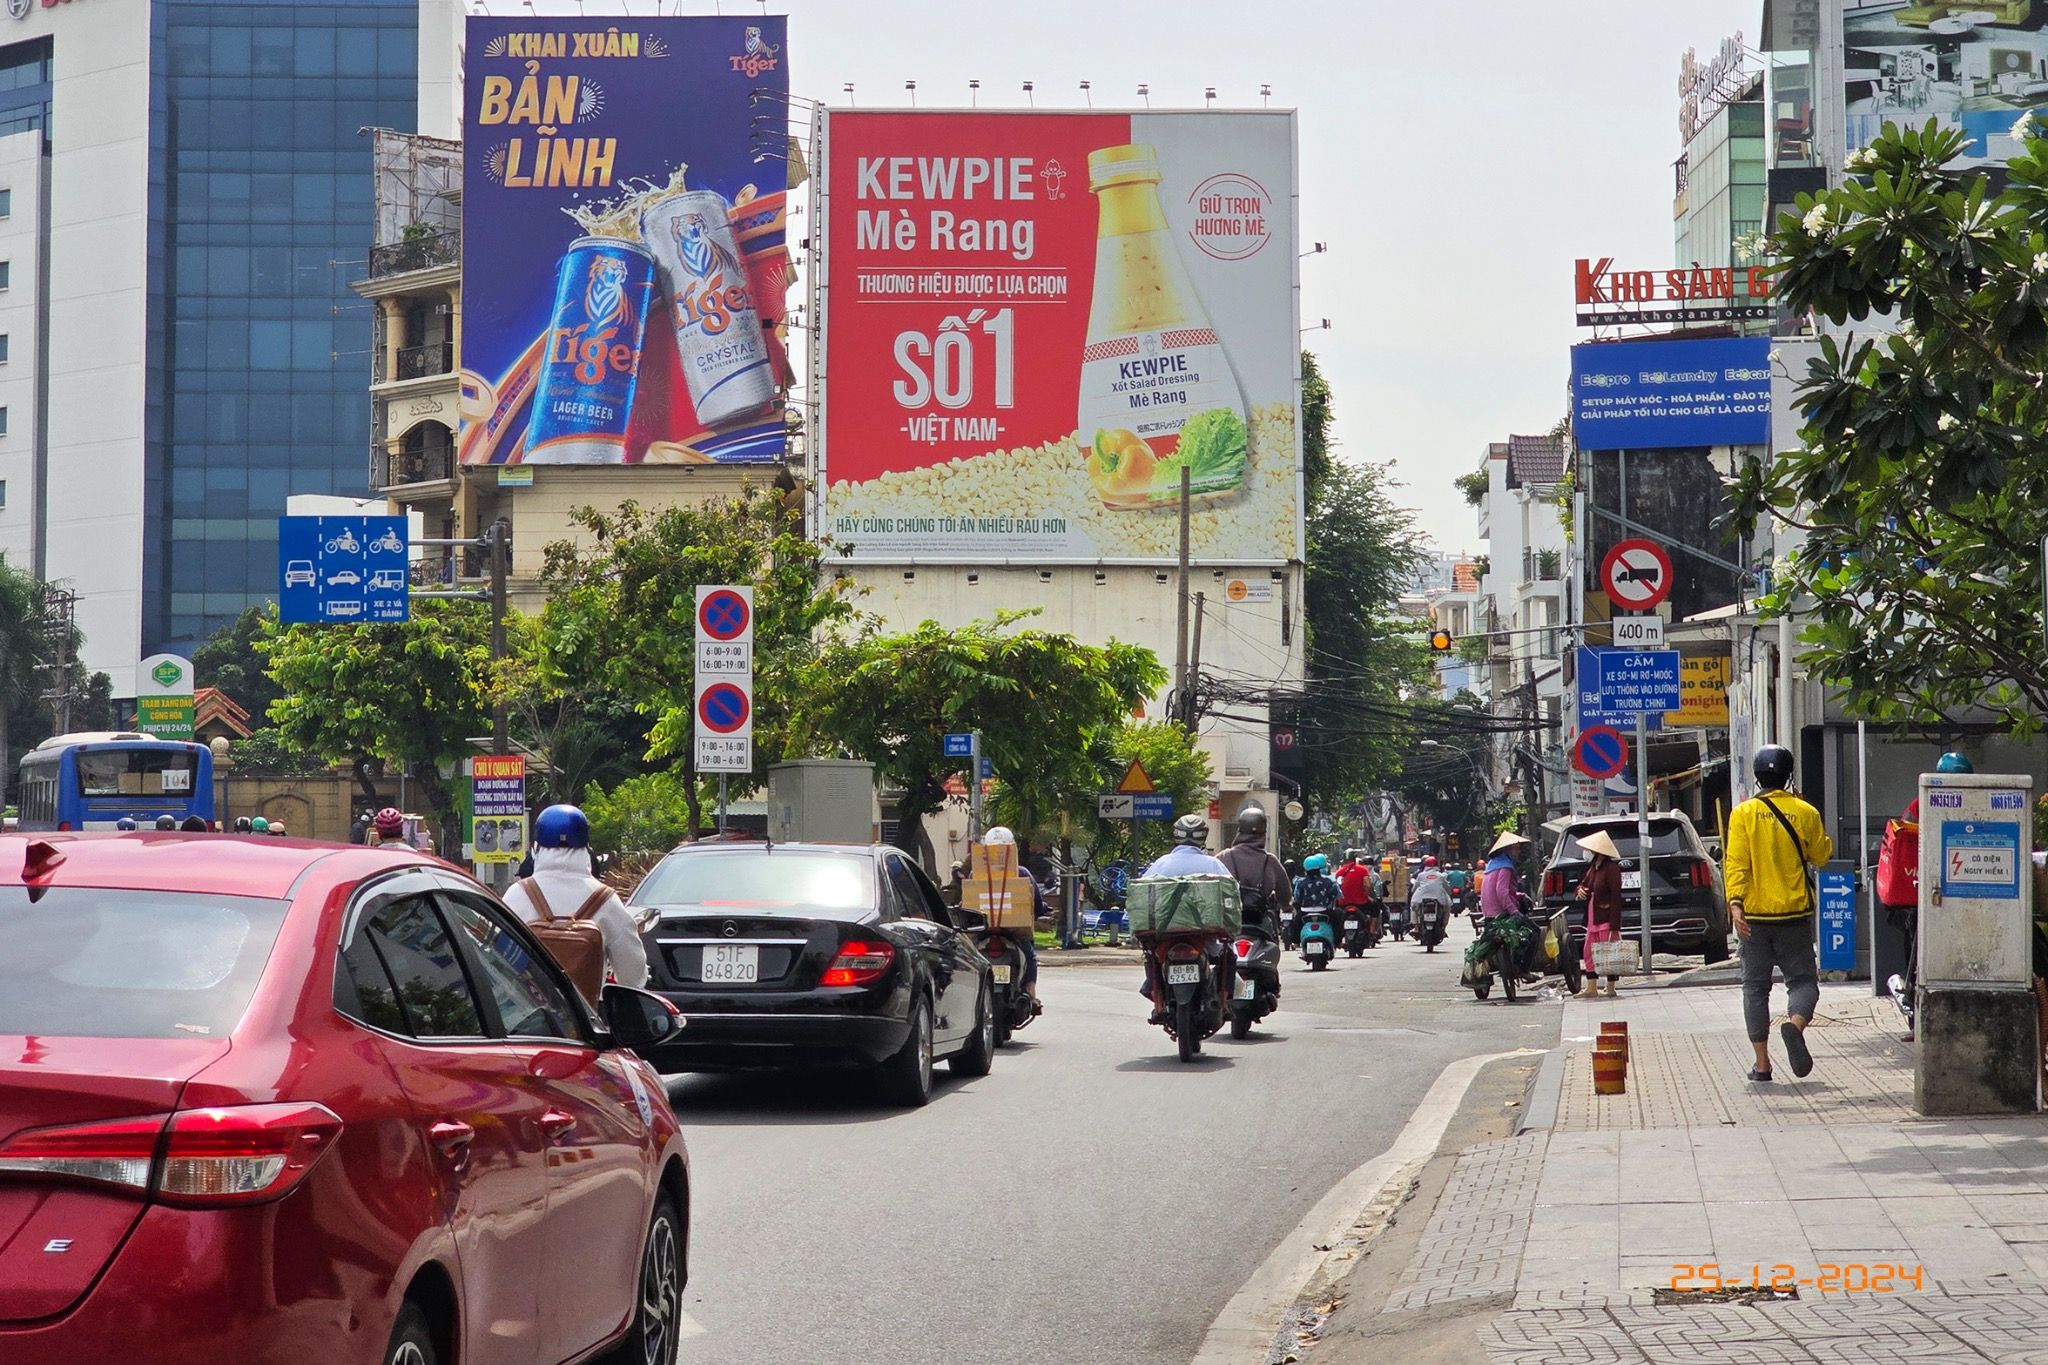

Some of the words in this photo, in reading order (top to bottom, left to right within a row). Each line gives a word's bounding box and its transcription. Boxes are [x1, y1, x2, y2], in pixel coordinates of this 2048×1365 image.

[508, 33, 567, 58] KHAI
[573, 27, 639, 58] XUÂN
[729, 55, 778, 79] Tiger
[479, 61, 579, 126] BẢN
[504, 126, 617, 188] LĨNH
[857, 158, 1034, 201] KEWPIE
[1200, 193, 1222, 214] GIỮ
[1225, 197, 1260, 217] TRỌN
[1195, 218, 1241, 235] HƯƠNG
[1245, 215, 1265, 235] MÈ
[857, 210, 916, 251] Mè
[931, 210, 1034, 260] Rang
[858, 272, 915, 294] THƯƠNG
[919, 272, 952, 297] HIỆU
[955, 274, 994, 297] ĐƯỢC
[997, 274, 1025, 297] LỰA
[1028, 274, 1067, 298] CHỌN
[1575, 257, 1655, 304] KHO
[1666, 261, 1733, 299] SÀN
[697, 342, 755, 368] CRYSTAL
[1120, 355, 1188, 379] KEWPIE
[1112, 381, 1129, 392] Xốt
[1130, 378, 1157, 390] Salad
[1158, 372, 1200, 386] Dressing
[1581, 374, 1631, 388] Ecopro
[1639, 370, 1718, 385] EcoLaundry
[1129, 393, 1150, 408] Mè
[1152, 390, 1187, 404] Rang
[1582, 399, 1614, 407] SETUP
[1615, 396, 1638, 406] MÁY
[1640, 394, 1662, 405] MÓC
[1671, 393, 1694, 403] HOÁ
[1695, 390, 1725, 403] PHẨM
[1733, 389, 1756, 401] ĐÀO
[553, 401, 585, 416] LAGER
[588, 405, 613, 420] BEER
[1604, 408, 1631, 419] PHÁP
[1633, 405, 1650, 417] TỐI
[1652, 407, 1667, 416] ƯU
[1669, 407, 1691, 416] CHO
[1693, 405, 1716, 417] GIẶT
[1718, 403, 1732, 414] LÀ
[1733, 405, 1755, 414] CAO
[836, 516, 860, 533] HÃY
[863, 515, 893, 533] CÙNG
[896, 515, 935, 533] CHÚNG
[938, 515, 956, 533] TÔI
[959, 516, 975, 533] ĂN
[978, 513, 1013, 533] NHIỀU
[1016, 519, 1039, 533] RAU
[1042, 517, 1066, 533] HƠN
[1619, 625, 1642, 639] 400
[1646, 628, 1658, 639] m
[706, 647, 742, 656] 6:00-9:00
[702, 660, 746, 669] 16:00-19:00
[1624, 653, 1654, 667] CẤM
[1703, 657, 1719, 672] gỗ
[1606, 672, 1615, 681] XE
[1617, 671, 1639, 681] SƠ-MI
[1681, 680, 1695, 689] ao
[1700, 676, 1724, 691] cấp
[1602, 686, 1615, 696] LƯU
[1617, 683, 1639, 695] THÔNG
[1641, 683, 1652, 694] VÀO
[1654, 682, 1678, 694] ĐƯỜNG
[1582, 692, 1600, 704] Ec
[1615, 697, 1642, 708] TRƯỜNG
[1645, 698, 1666, 708] CHINH
[171, 722, 192, 732] 24/24
[702, 742, 717, 751] 9:00
[725, 742, 745, 751] 16:00
[474, 759, 487, 776] CHÚ
[493, 762, 510, 778] QUAN
[511, 758, 523, 776] SÁT
[702, 755, 717, 765] 19:00
[729, 755, 745, 765] 6:00
[164, 774, 188, 787] 104
[1971, 853, 1981, 862] CÓ
[1964, 867, 1982, 875] NGUY
[1832, 934, 1844, 950] P
[716, 946, 745, 963] 51F
[705, 964, 755, 980] 848.20
[1169, 974, 1199, 983] 525.44
